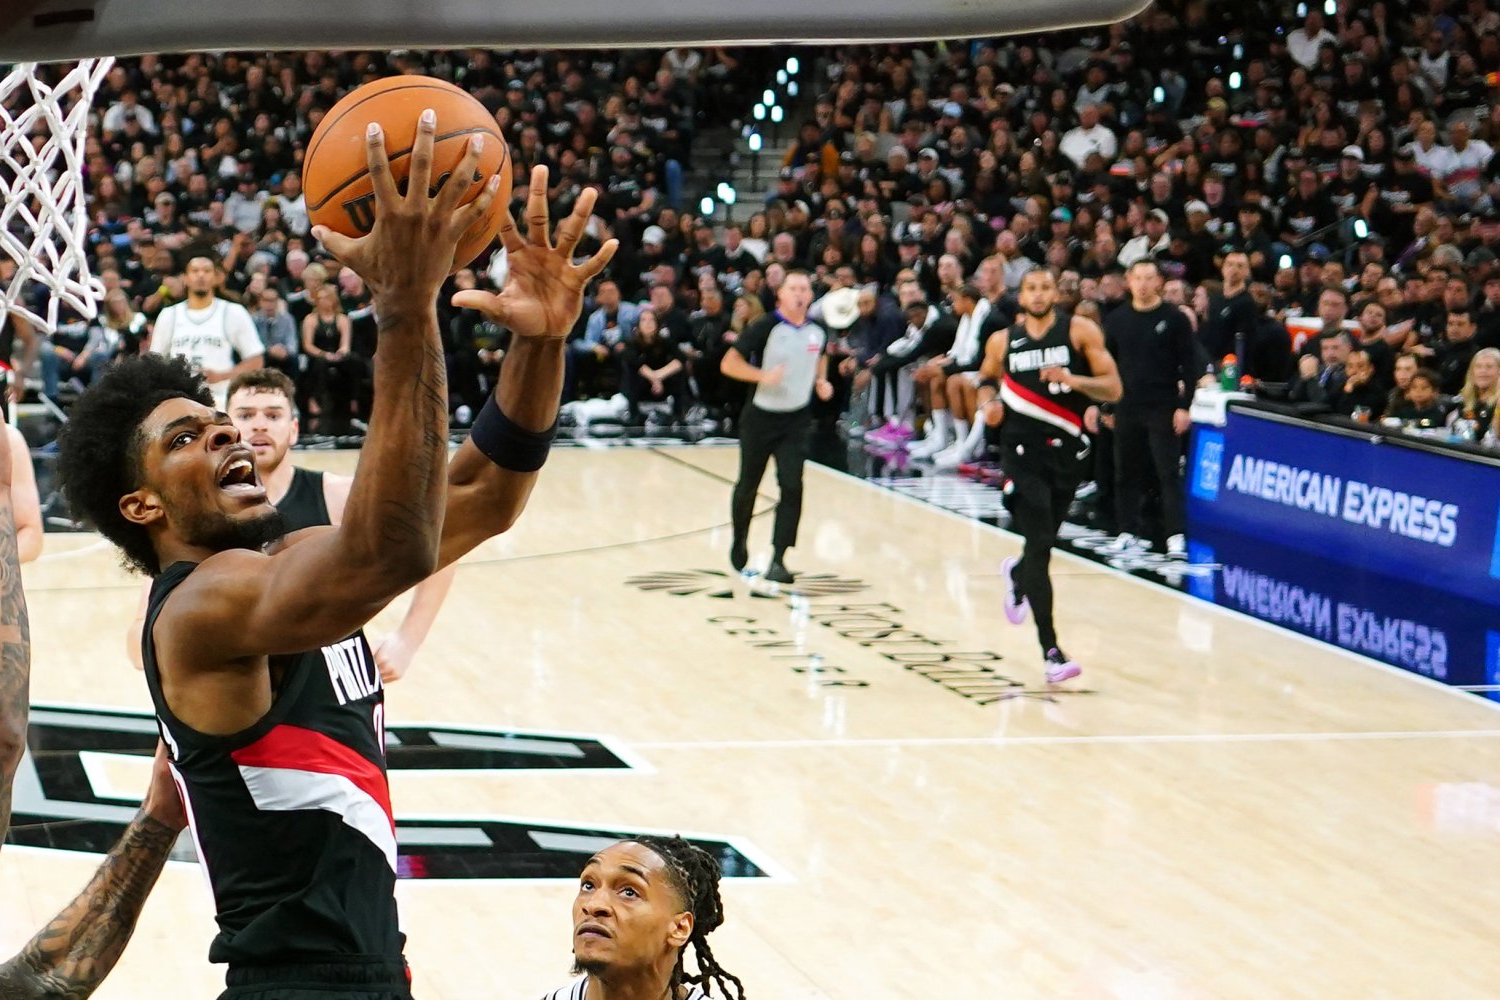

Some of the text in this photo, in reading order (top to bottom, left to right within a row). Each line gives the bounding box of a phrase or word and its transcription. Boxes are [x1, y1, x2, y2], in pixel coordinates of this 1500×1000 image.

[1008, 344, 1071, 373] PORTLAND
[1226, 454, 1341, 517] AMERICAN
[1342, 480, 1459, 547] EXPRESS
